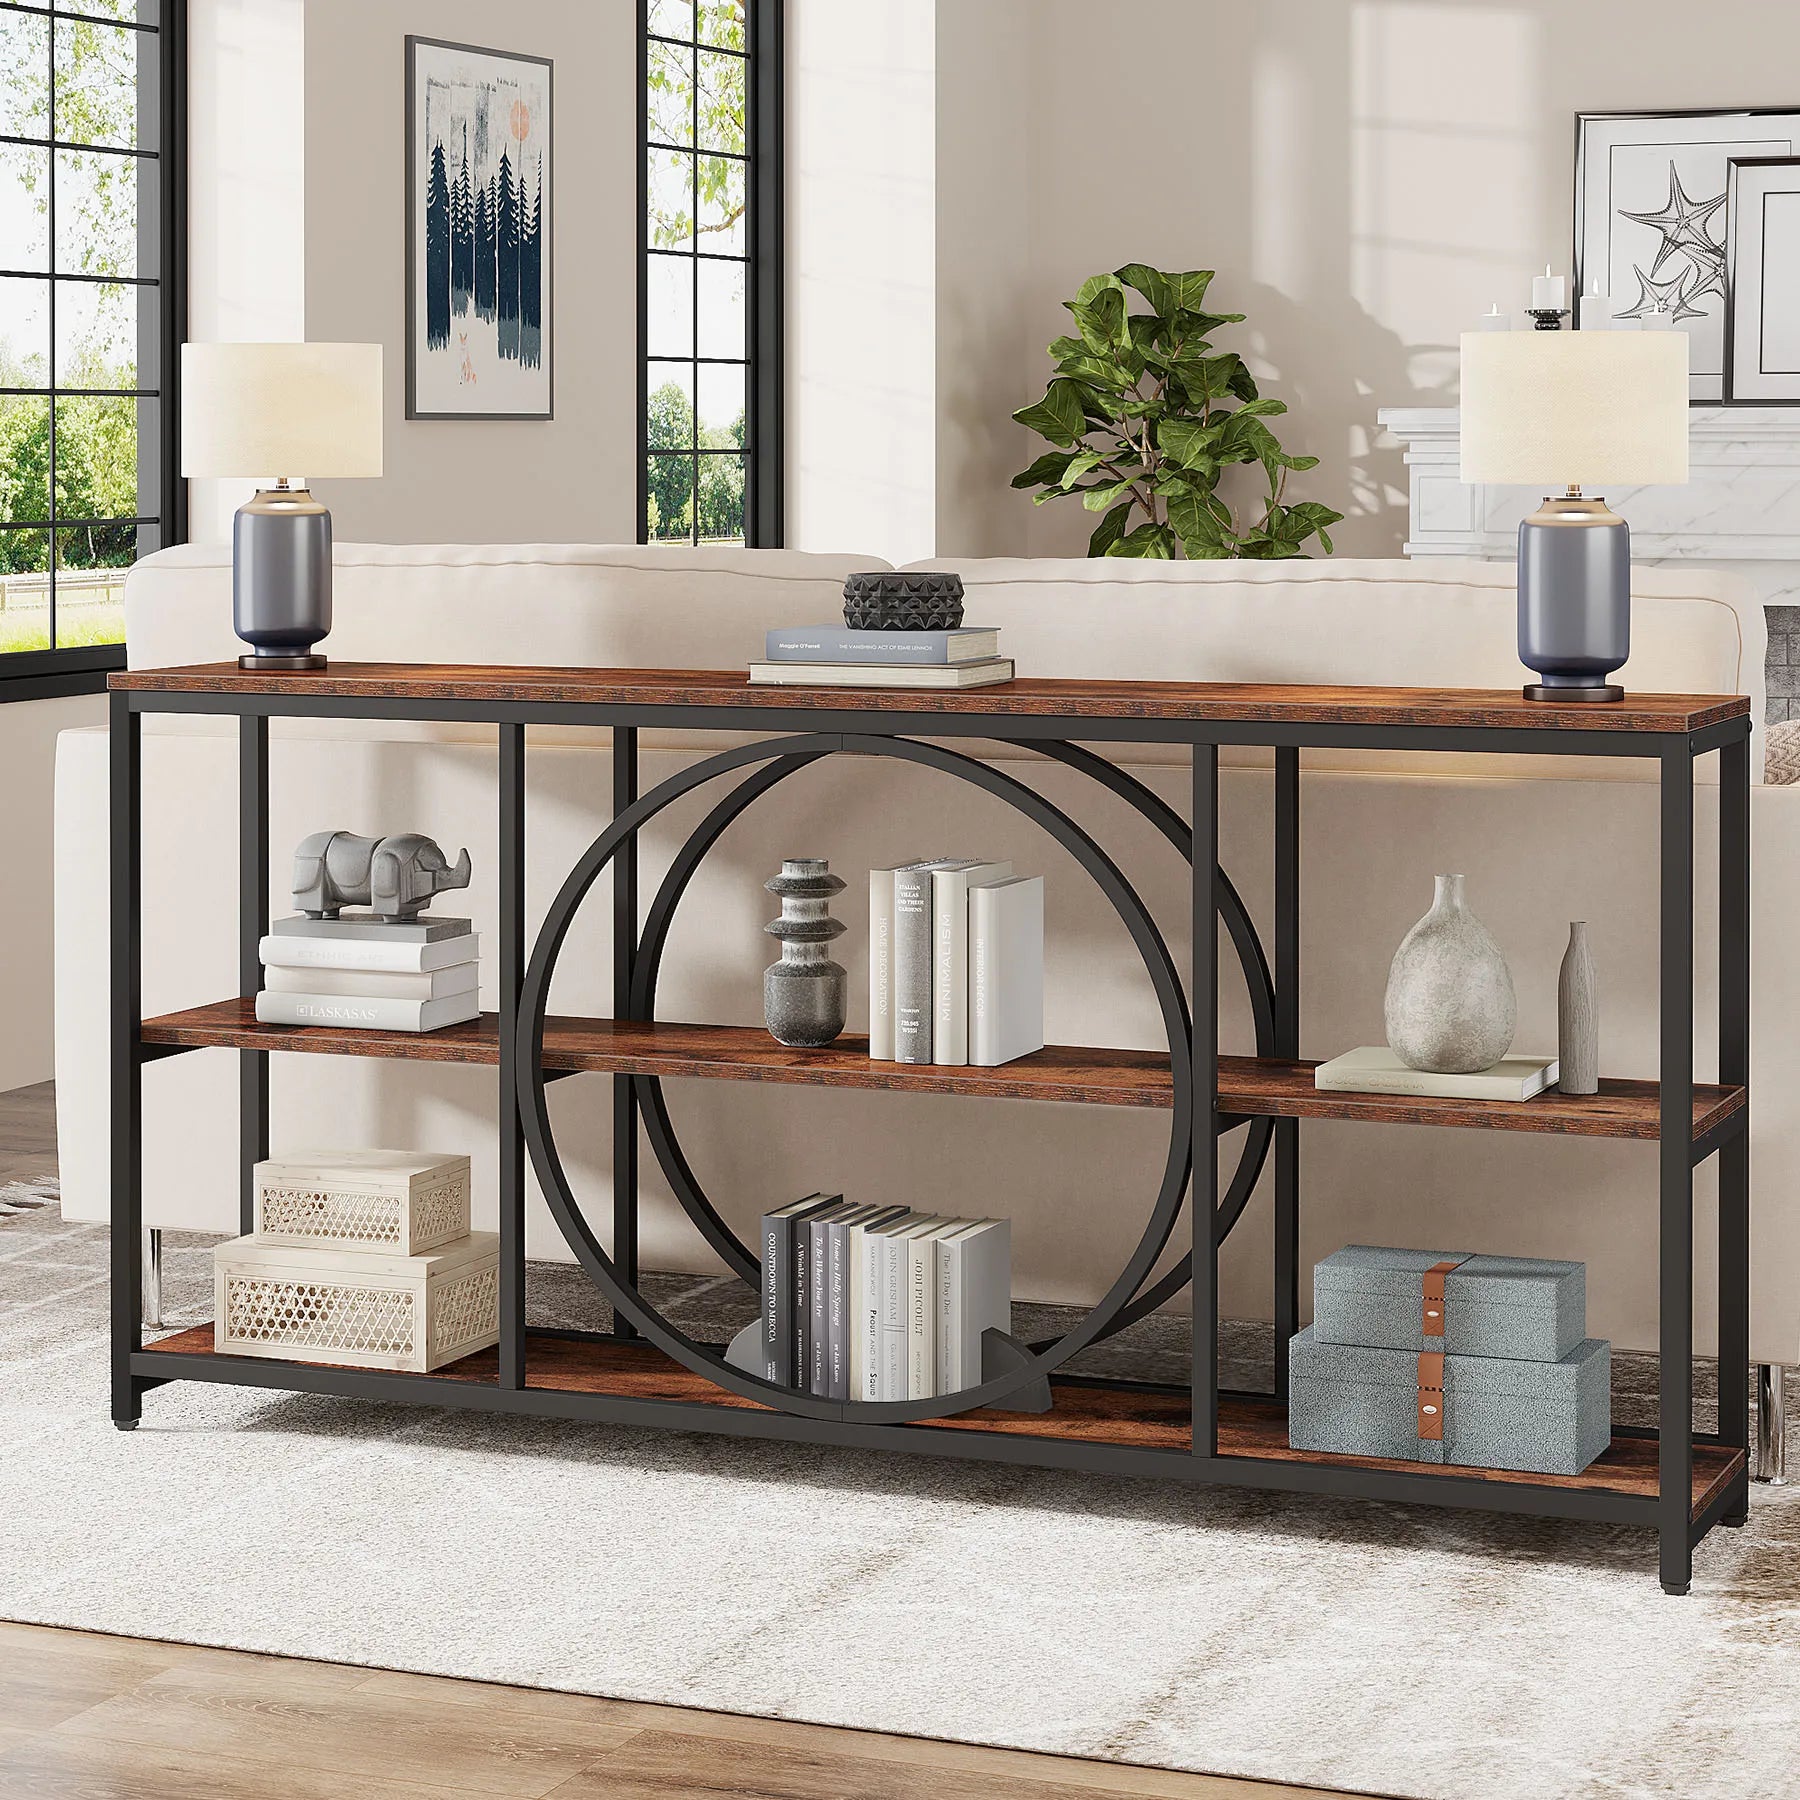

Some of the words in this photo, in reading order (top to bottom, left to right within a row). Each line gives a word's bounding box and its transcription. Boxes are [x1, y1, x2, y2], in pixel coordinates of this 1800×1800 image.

[942, 914, 952, 1020] MINIMALISM
[310, 1006, 376, 1020] LASKASAS
[816, 1236, 822, 1247] To
[816, 1249, 822, 1258] Be
[888, 1246, 896, 1272] JOHN
[768, 1232, 776, 1294] COUNTDOWN
[834, 1262, 840, 1270] to
[833, 1272, 841, 1294] Holly
[944, 1271, 950, 1279] 17
[768, 1295, 776, 1308] TO
[888, 1275, 897, 1320] GRISHAM
[833, 1295, 841, 1326] Springs
